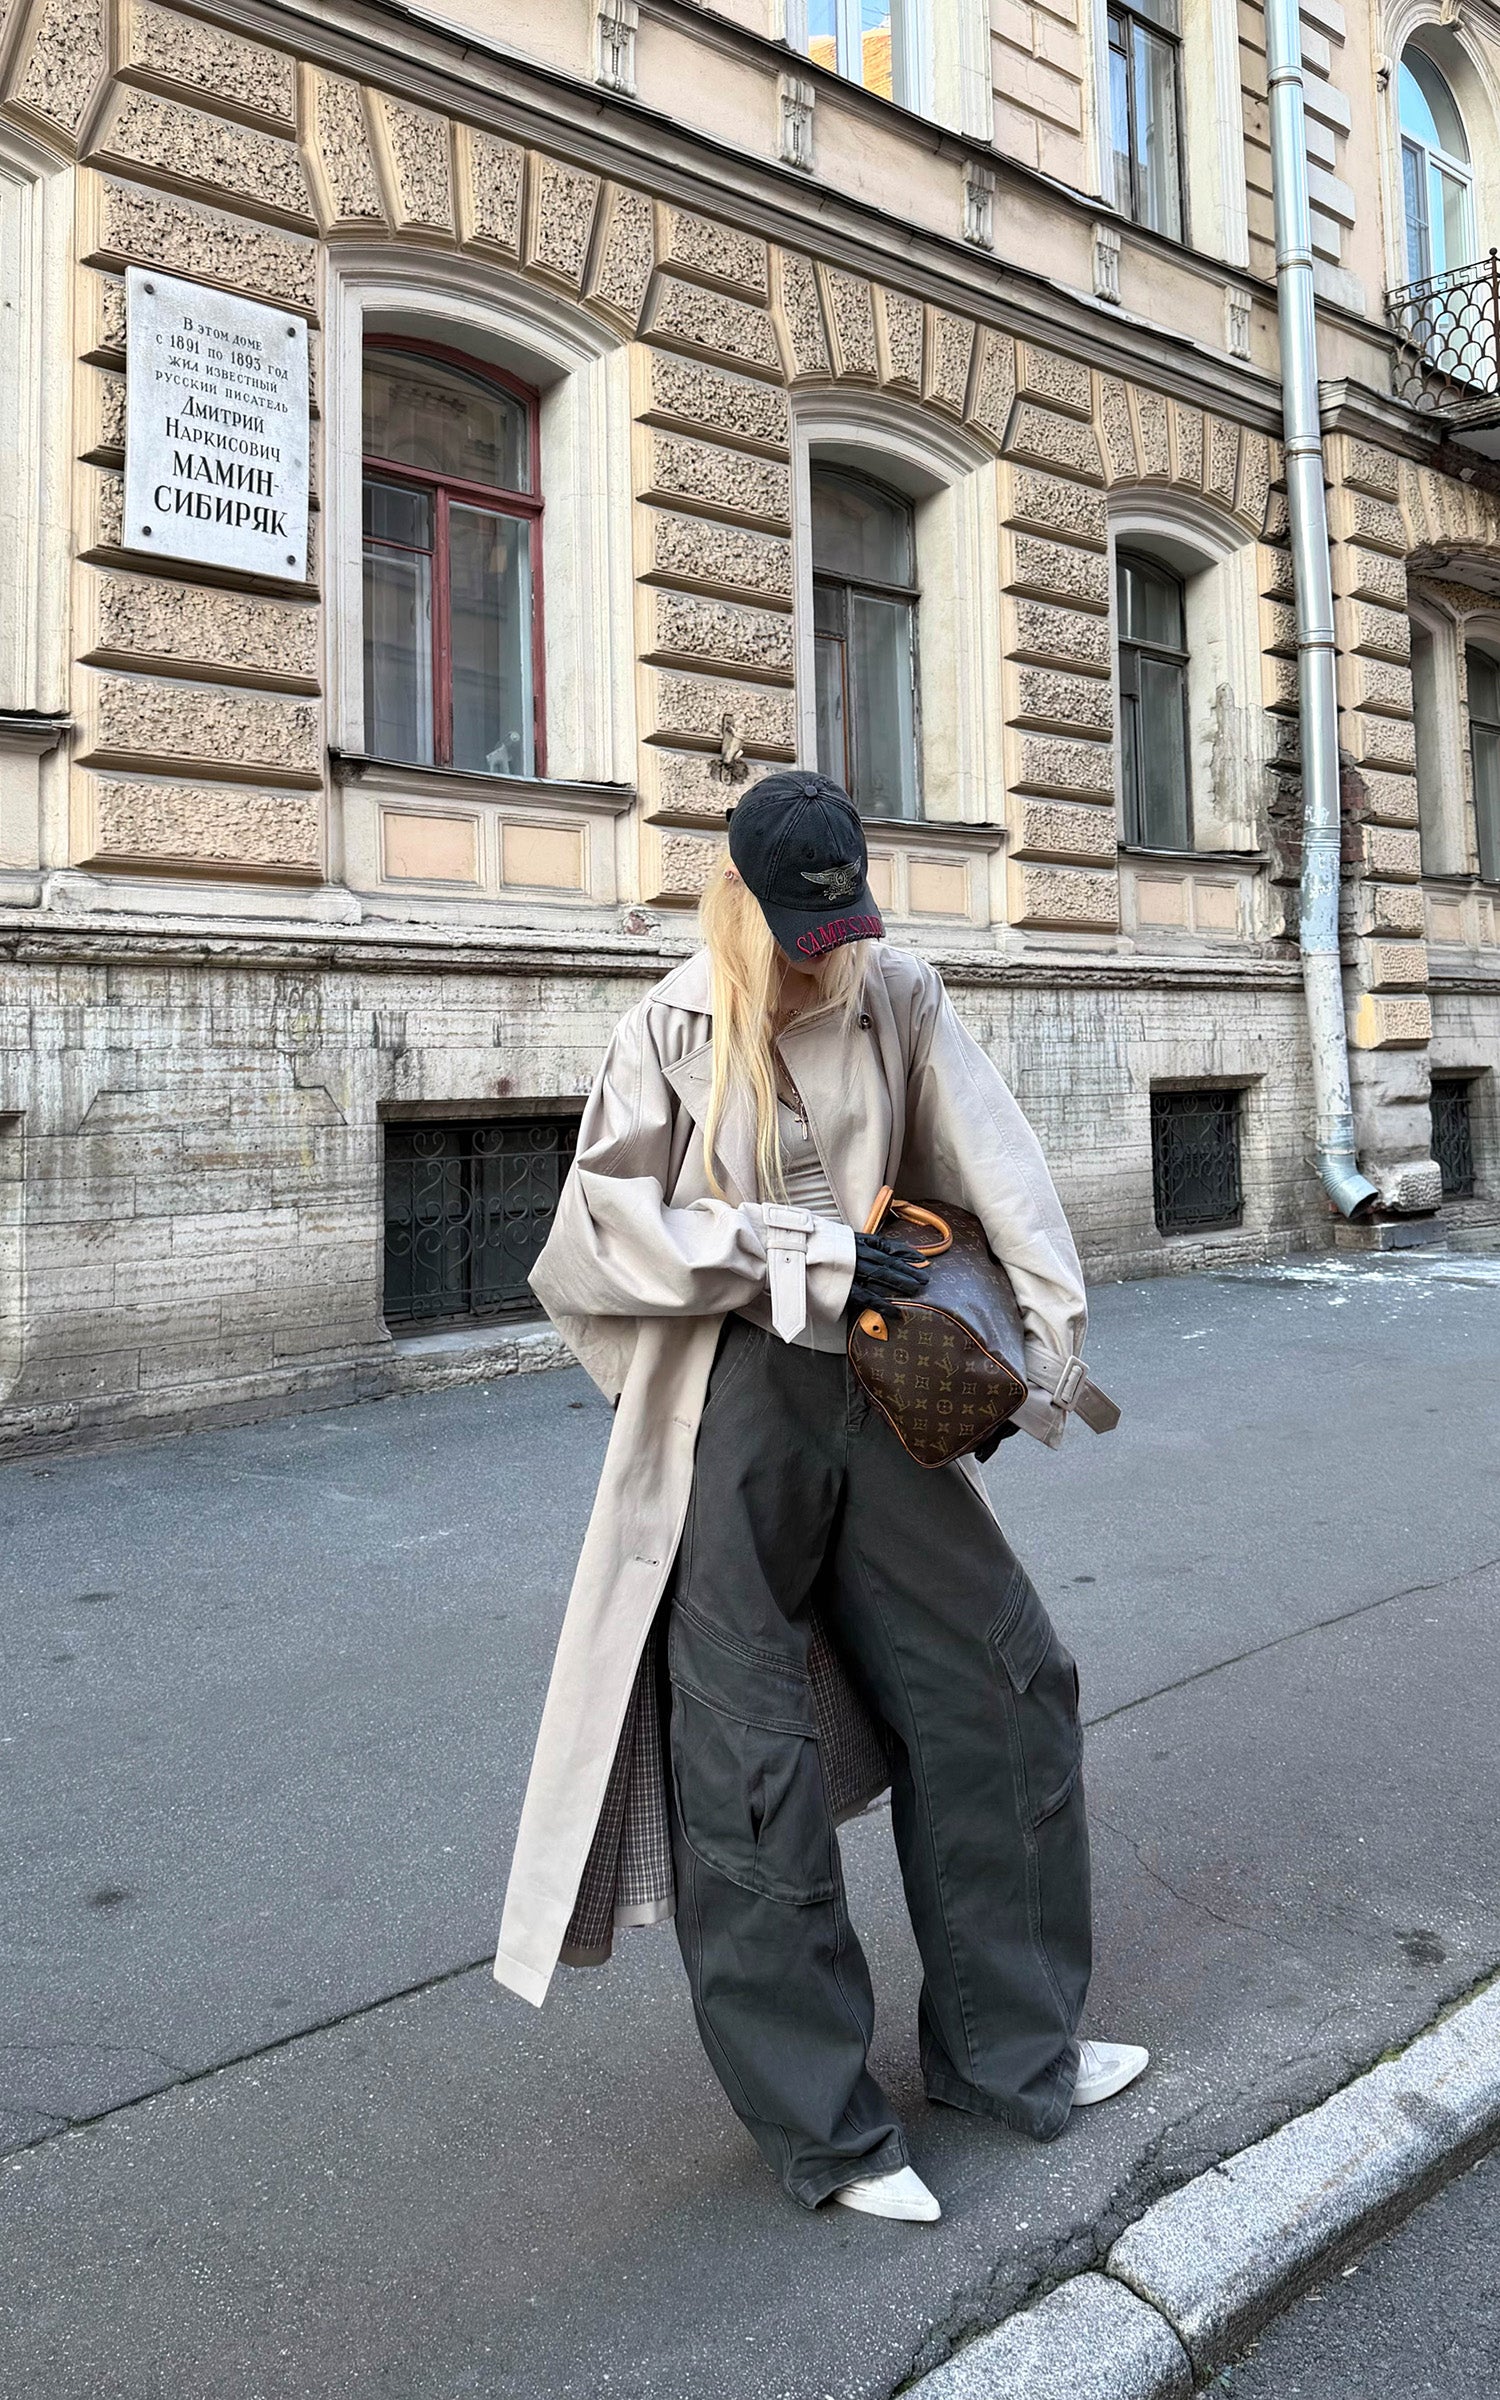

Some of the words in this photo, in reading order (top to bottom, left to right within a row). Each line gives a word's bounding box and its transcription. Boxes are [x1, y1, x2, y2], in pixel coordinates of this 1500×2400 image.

[183, 317, 193, 331] В
[170, 334, 200, 355] 1891
[230, 351, 261, 372] 1893
[154, 484, 289, 539] СИБИРЯК
